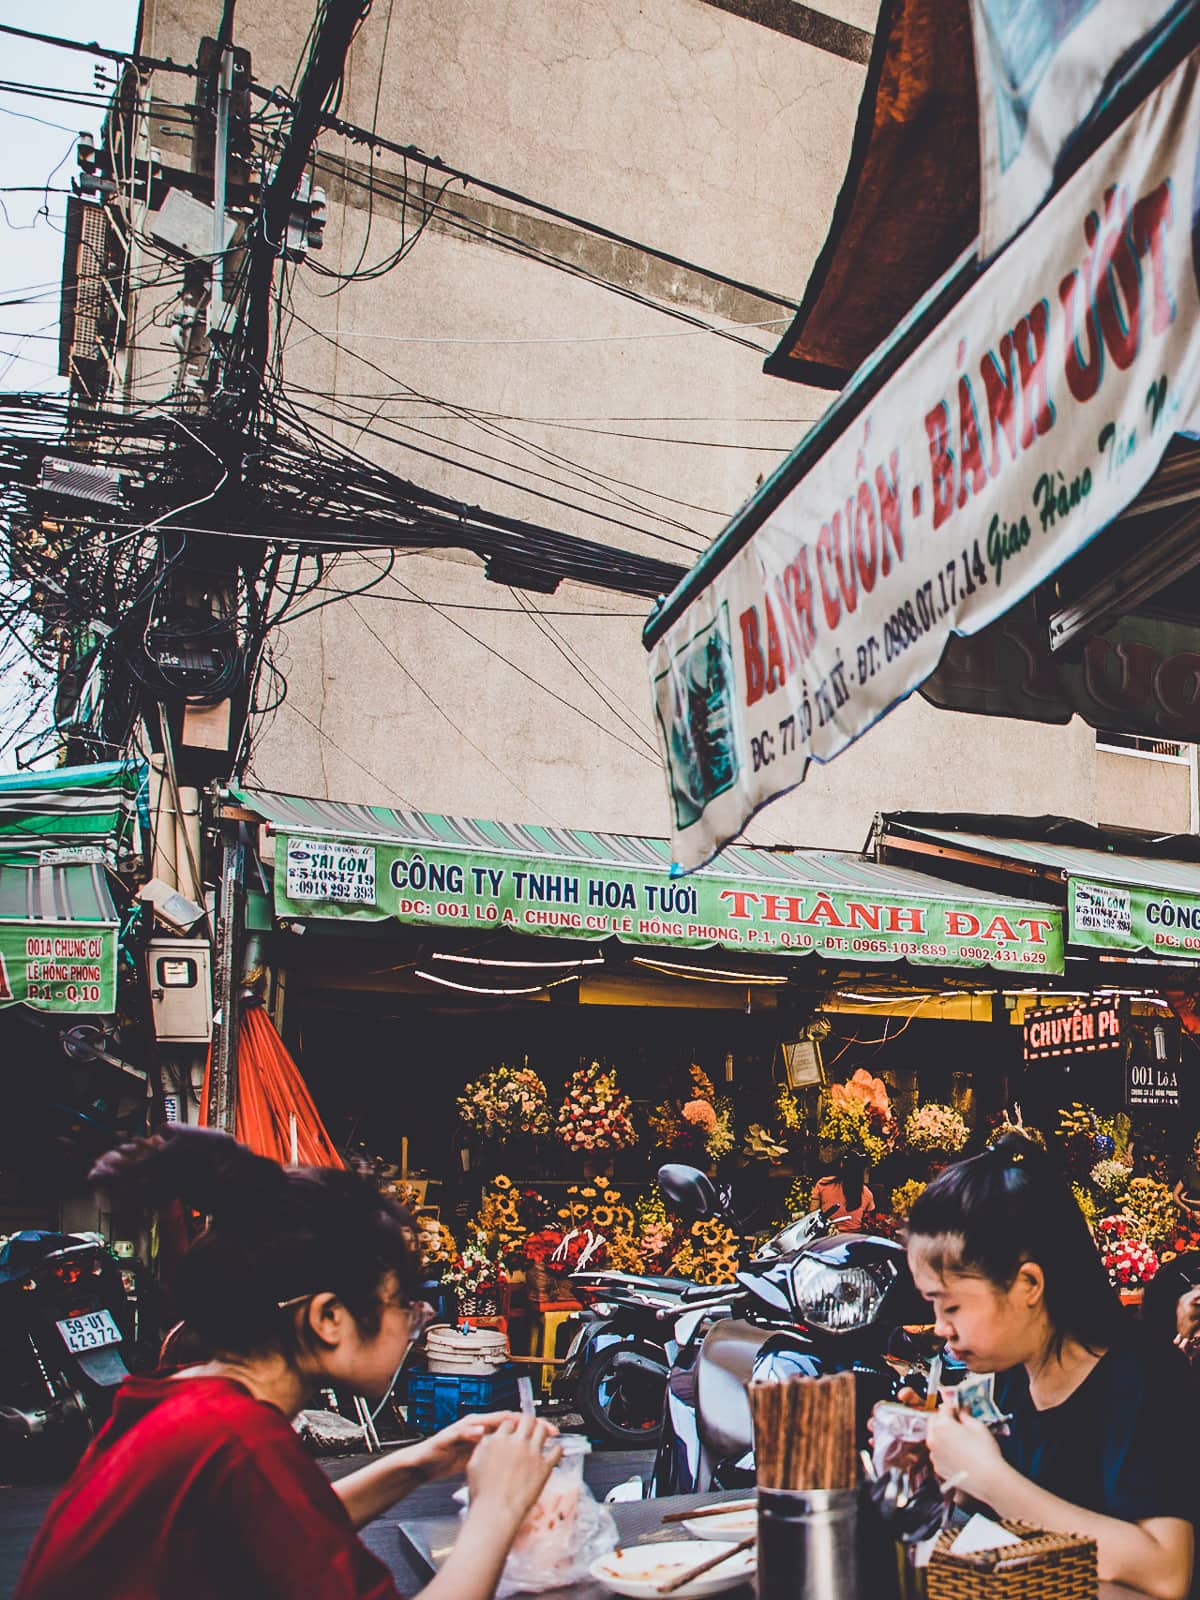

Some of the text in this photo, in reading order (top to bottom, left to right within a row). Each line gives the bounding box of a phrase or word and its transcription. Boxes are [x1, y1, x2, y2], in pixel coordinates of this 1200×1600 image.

[924, 297, 1056, 531] BÁNH
[986, 512, 1031, 587] Giao
[391, 855, 1054, 948] CÔNG TY TNHH HOA TƯƠI THÀNH ĐẠT
[400, 900, 430, 916] ĐC:
[436, 905, 469, 919] 001
[476, 904, 498, 922] LÔ
[503, 909, 520, 924] A,
[525, 911, 582, 929] CHUNG
[613, 916, 632, 932] LÊ
[688, 925, 744, 942] PHONG,
[748, 930, 777, 944] P.1,
[781, 933, 813, 947] Q.10
[853, 939, 947, 956] 0965.103.889
[960, 948, 1047, 964] 0902.431.629
[1155, 933, 1179, 946] ĐC:
[28, 938, 51, 955] 001A
[55, 939, 86, 957] CHUNG
[28, 961, 39, 980] LÊ
[71, 965, 100, 981] PHONG
[30, 985, 51, 1000] P.1
[67, 985, 99, 1002] Q.10
[1029, 1009, 1094, 1048] CHUYÊN
[1131, 1065, 1154, 1085] 001
[1170, 1071, 1178, 1087] A
[65, 1315, 105, 1334] 59-U1
